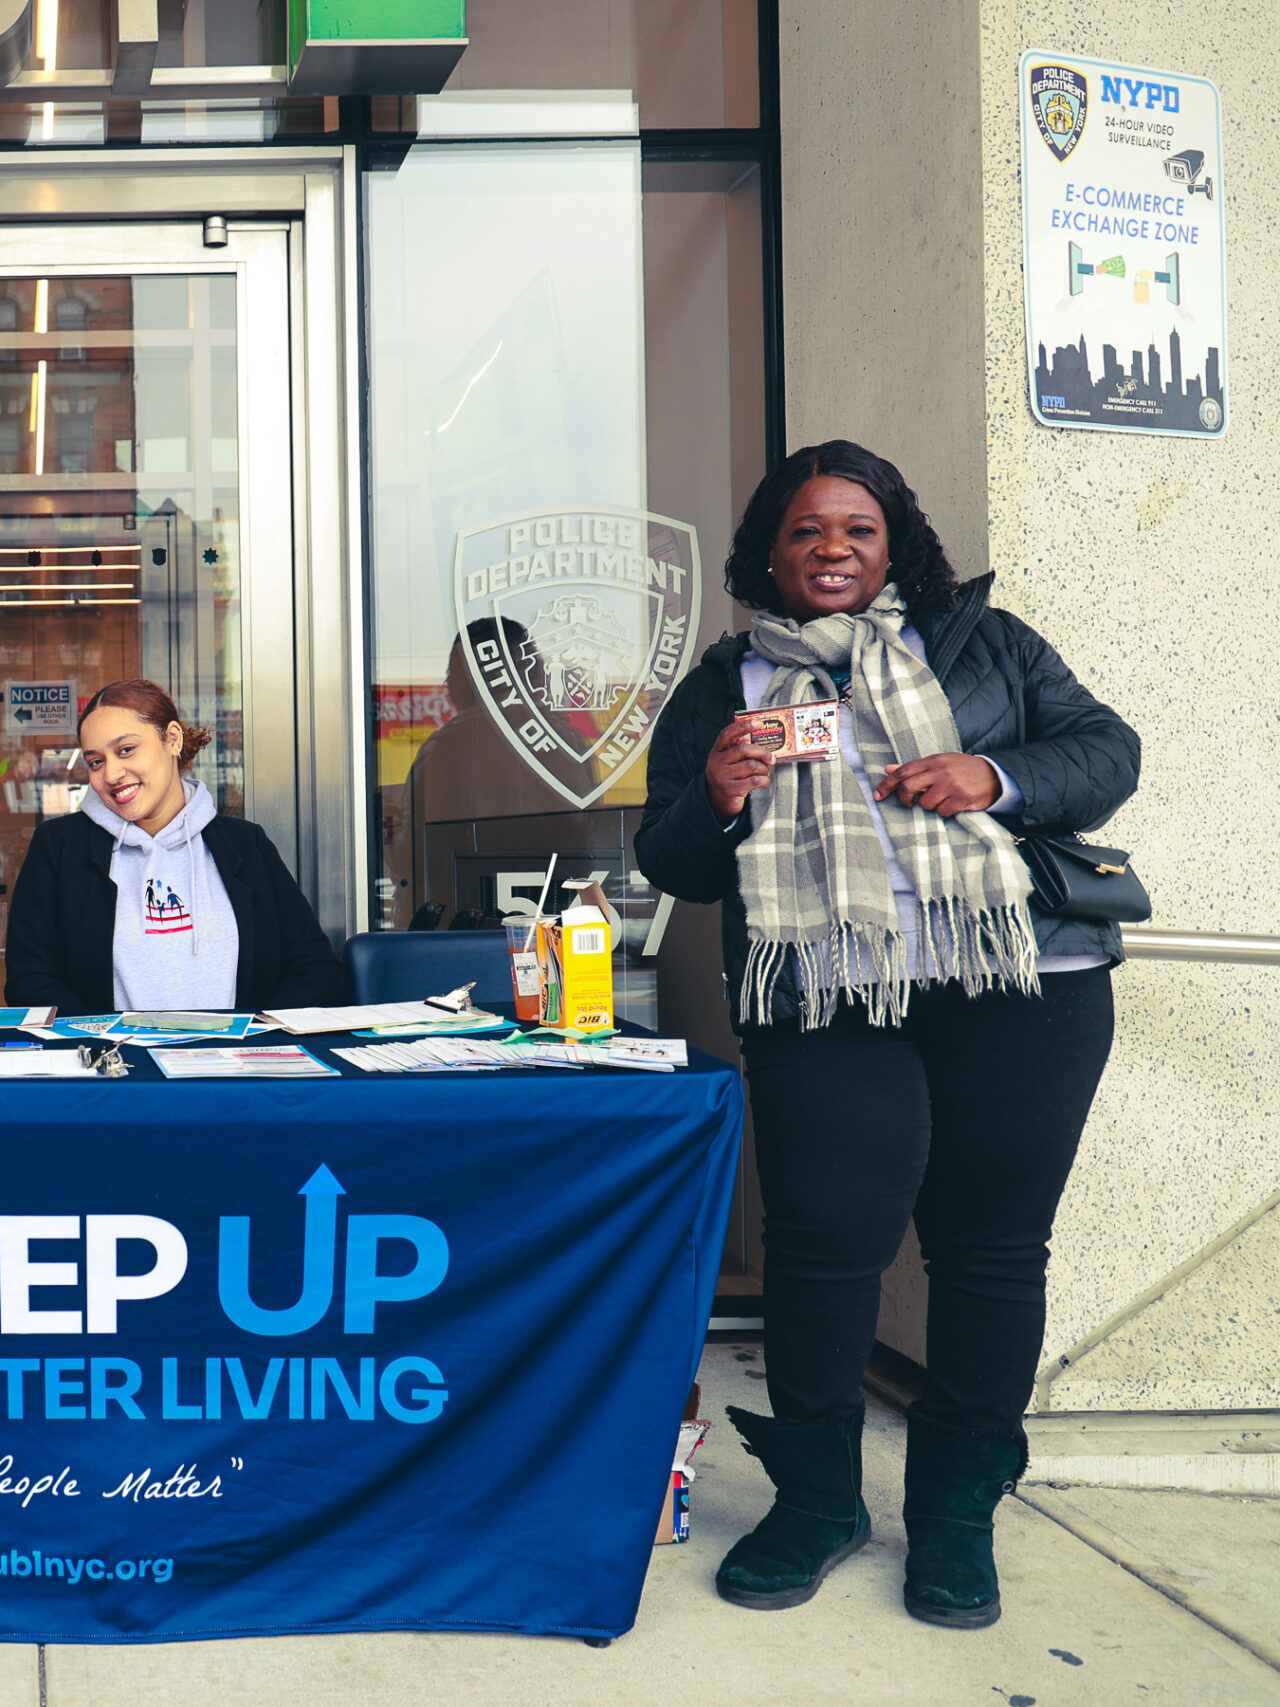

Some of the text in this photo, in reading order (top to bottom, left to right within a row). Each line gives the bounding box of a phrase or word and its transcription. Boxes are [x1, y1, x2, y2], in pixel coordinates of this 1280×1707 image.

[1032, 79, 1086, 101] DEPARTMENT
[1043, 68, 1074, 83] POLICE
[1101, 74, 1179, 113] NYPD
[1034, 103, 1054, 145] CITY OF
[1064, 107, 1086, 154] NEW YORK
[1105, 116, 1174, 136] 24-HOUR VIDEO
[1108, 132, 1171, 150] SURVEILLANCE
[1065, 183, 1184, 216] E-COMMERCE
[1051, 209, 1199, 245] EXCHANGE ZONE
[510, 514, 642, 553] POLICE
[468, 547, 687, 601] DEPARTMENT
[11, 688, 69, 701] NOTICE
[476, 639, 558, 754] CITY OF
[599, 614, 687, 768] NEW YORK
[578, 1015, 600, 1024] BIC
[218, 1162, 451, 1337] UP
[163, 1354, 450, 1424] LIVING
[103, 1457, 244, 1502] Matter”
